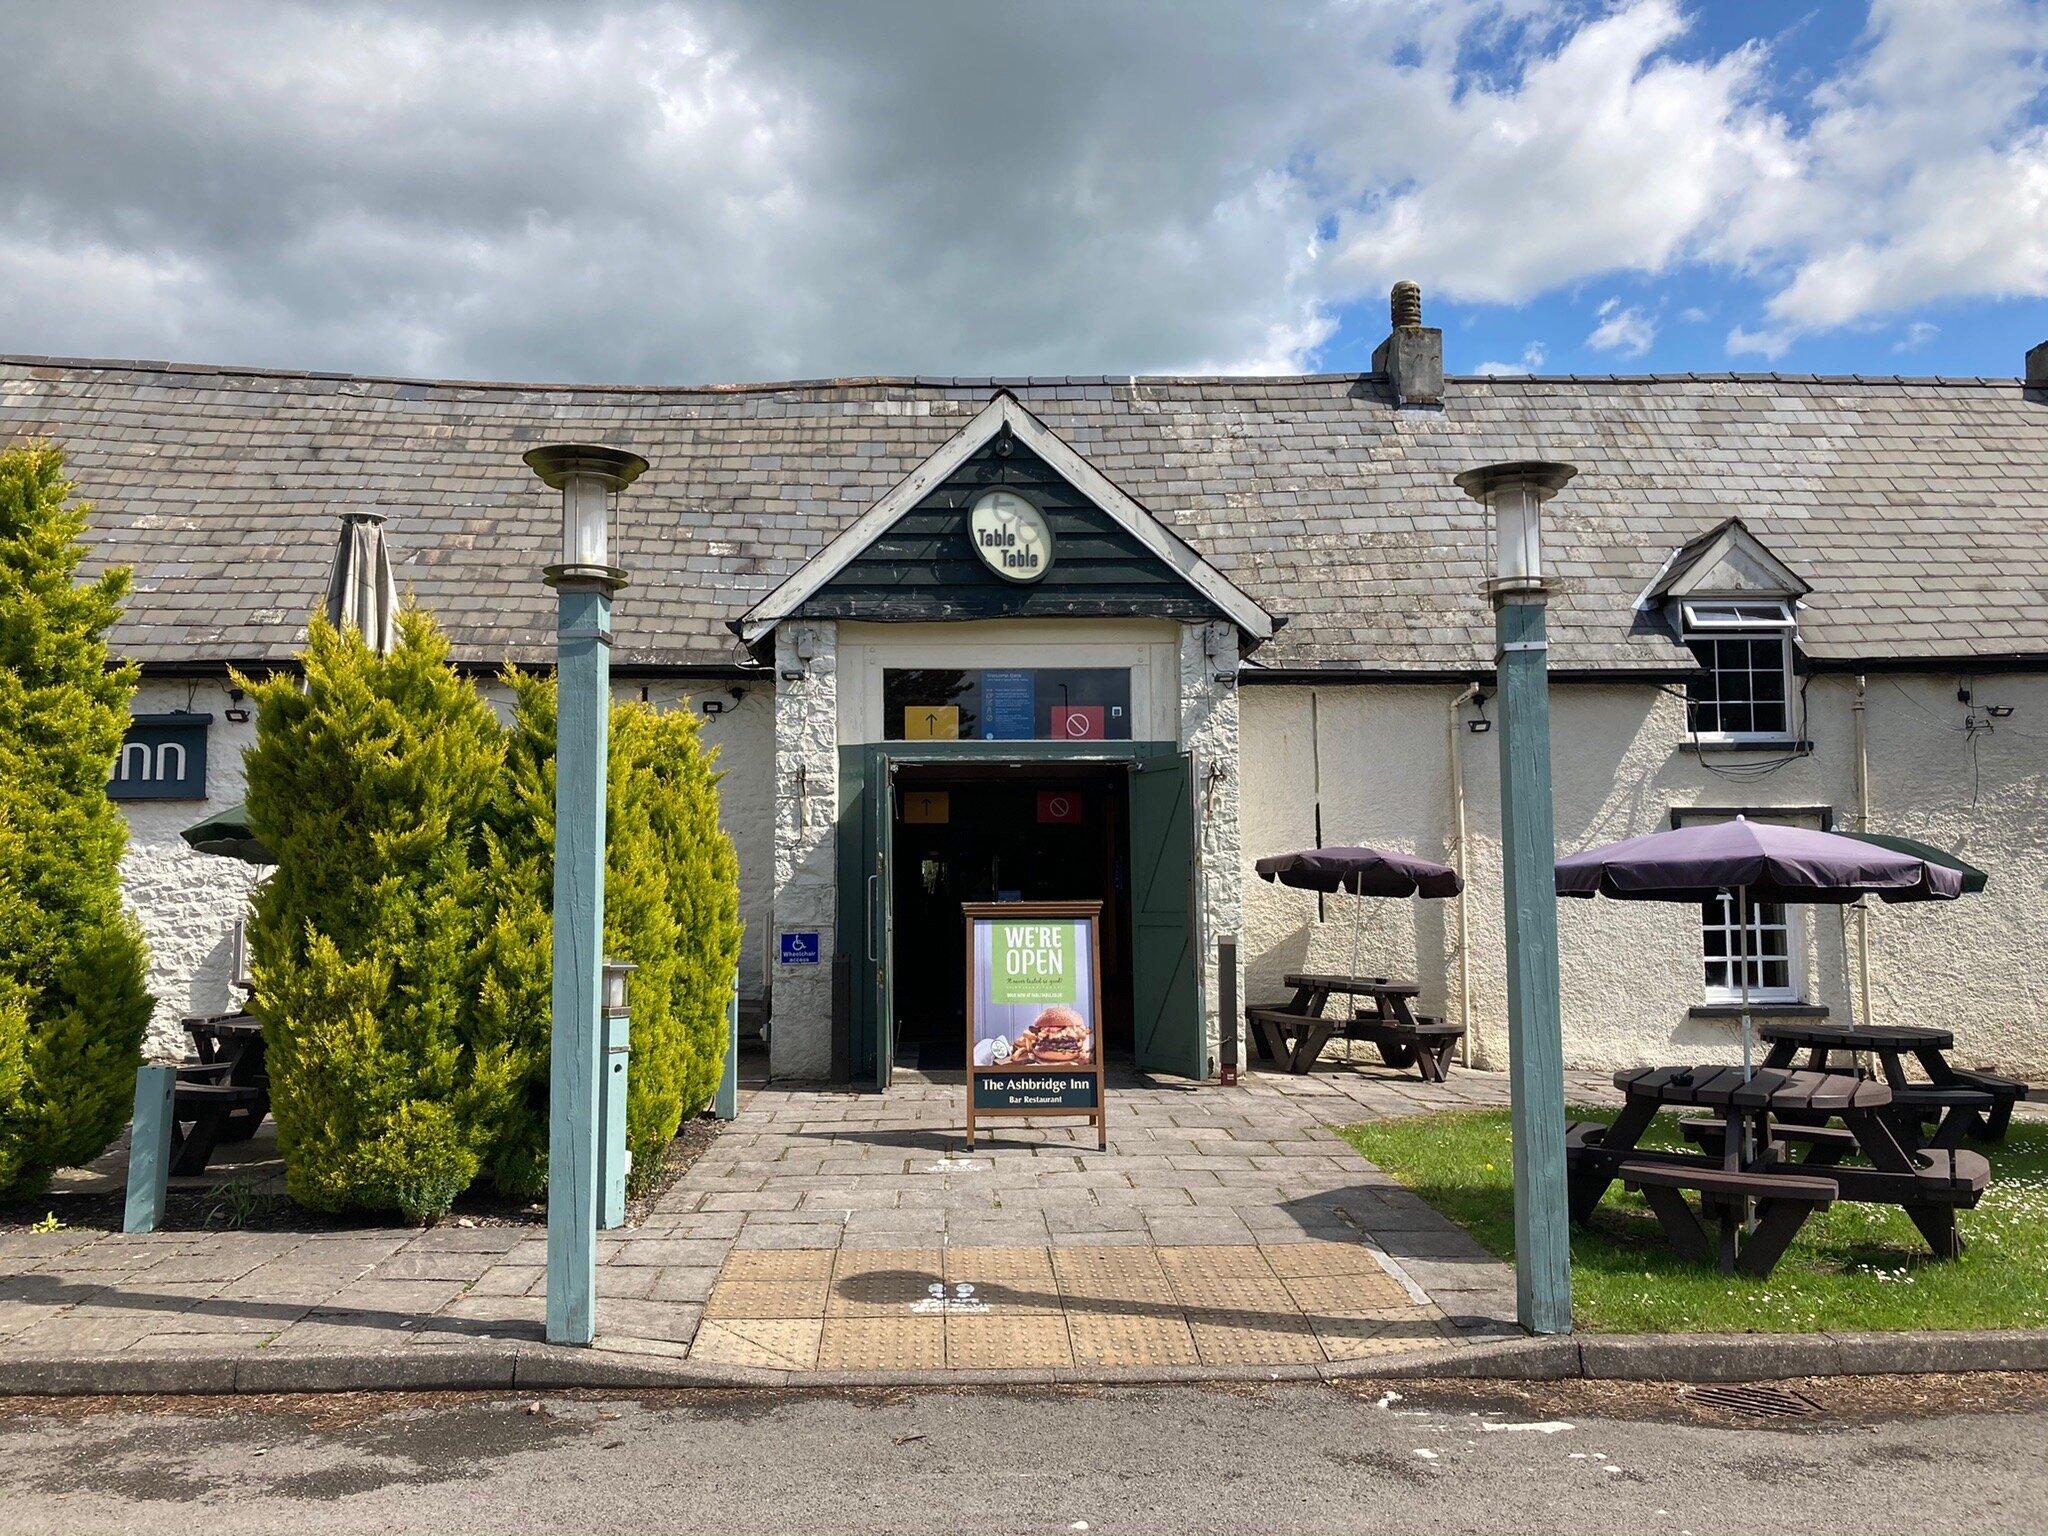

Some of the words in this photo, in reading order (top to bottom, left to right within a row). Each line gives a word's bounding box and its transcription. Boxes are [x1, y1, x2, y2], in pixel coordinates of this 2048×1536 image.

[978, 523, 1015, 547] Table
[1000, 543, 1038, 567] Table
[1004, 926, 1062, 948] WE'RE
[1006, 949, 1063, 975] OPEN
[982, 1078, 1004, 1090] The
[1006, 1078, 1066, 1093] Ashbridge
[1070, 1078, 1089, 1089] Inn
[1009, 1096, 1022, 1104] Bar
[1023, 1095, 1062, 1103] Restaurant
